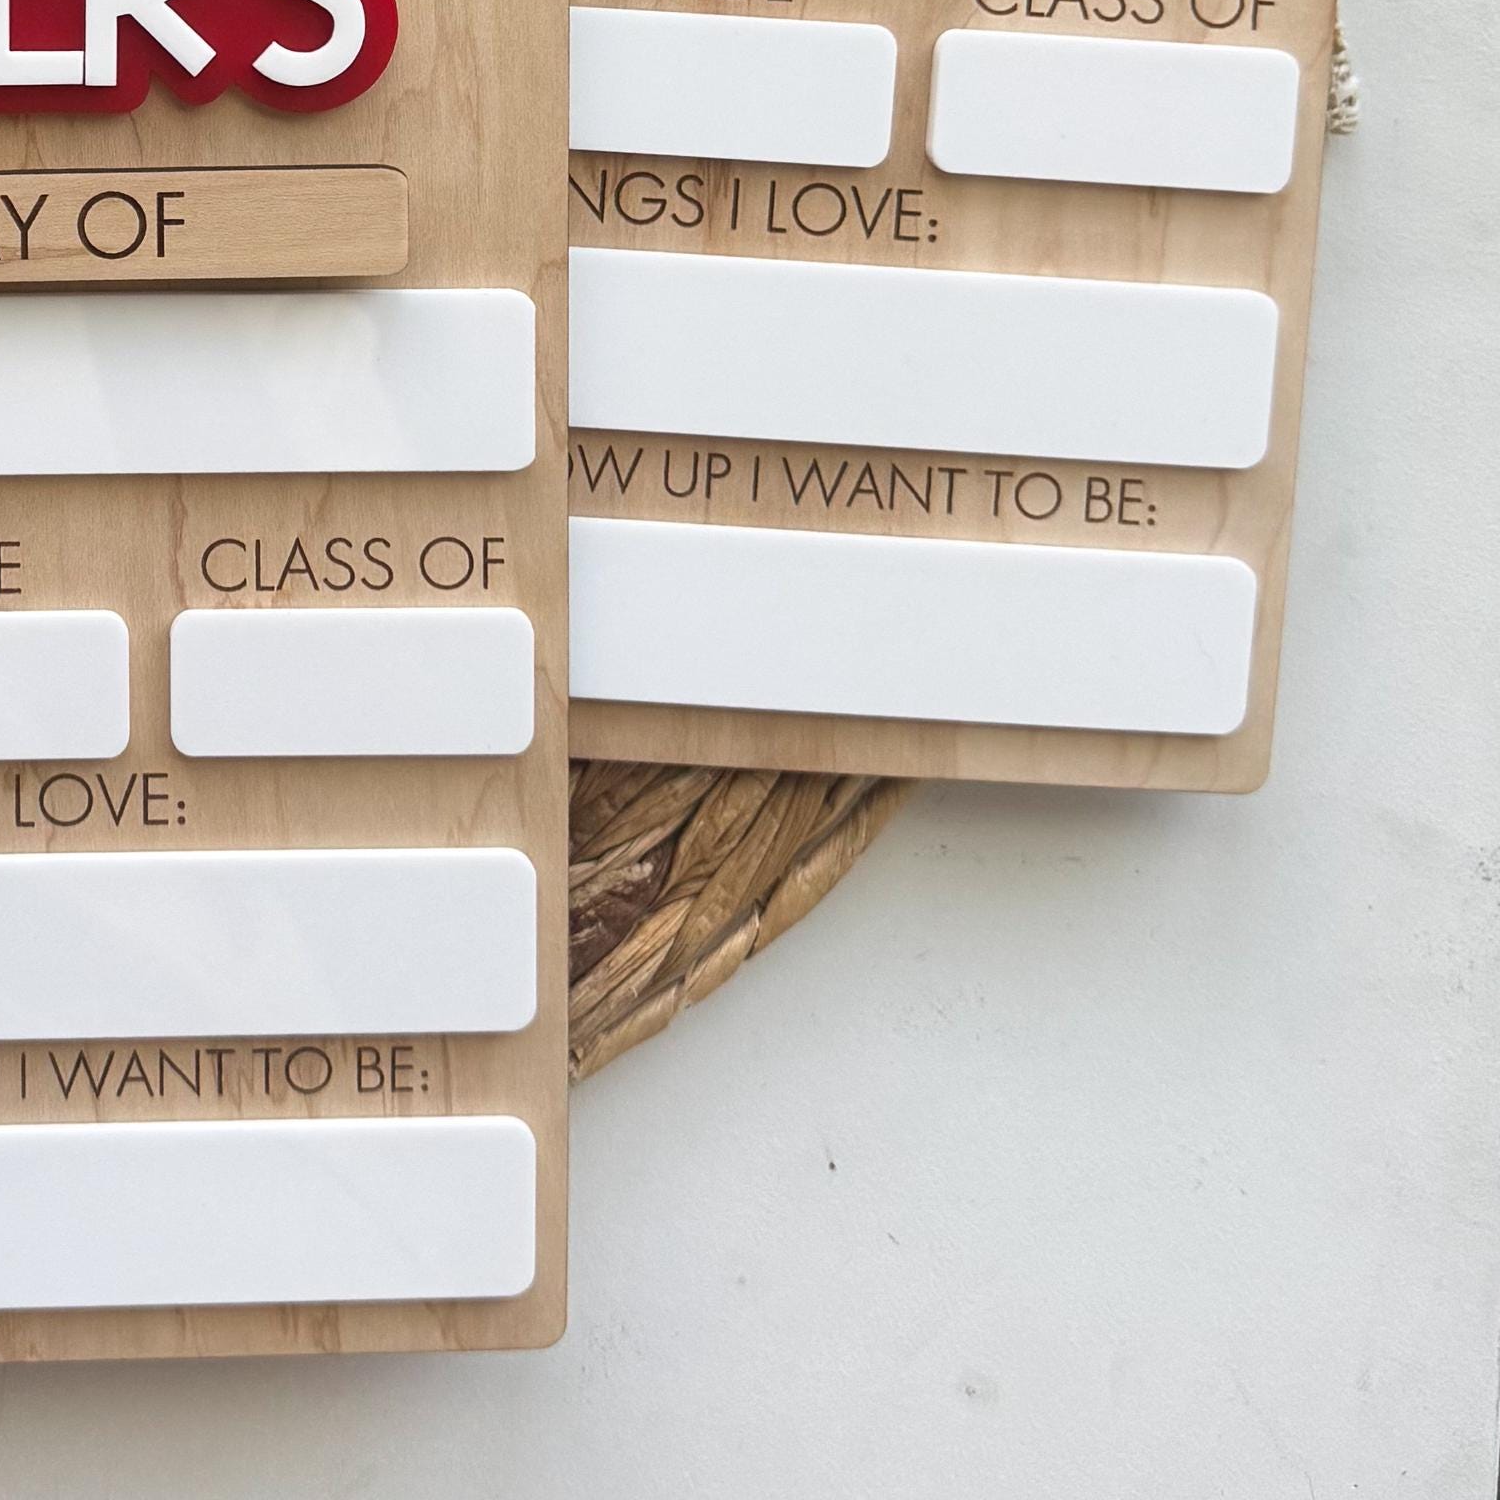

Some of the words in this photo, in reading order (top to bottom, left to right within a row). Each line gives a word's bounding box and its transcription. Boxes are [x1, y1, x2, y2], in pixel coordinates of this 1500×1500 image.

[77, 190, 185, 260] OF
[731, 177, 741, 230] I
[767, 179, 937, 243] LOVE:
[568, 444, 644, 494] W
[663, 449, 732, 499] UP
[752, 455, 760, 502] I
[781, 456, 968, 514] WANT
[983, 469, 1062, 520] TO
[1085, 476, 1157, 526] BE:
[201, 536, 394, 593] CLASS
[419, 536, 505, 590] OF
[14, 772, 186, 828] LOVE:
[20, 1051, 26, 1099] I
[48, 1048, 236, 1100] WANT
[251, 1046, 333, 1095] TO
[356, 1045, 433, 1093] BE:
